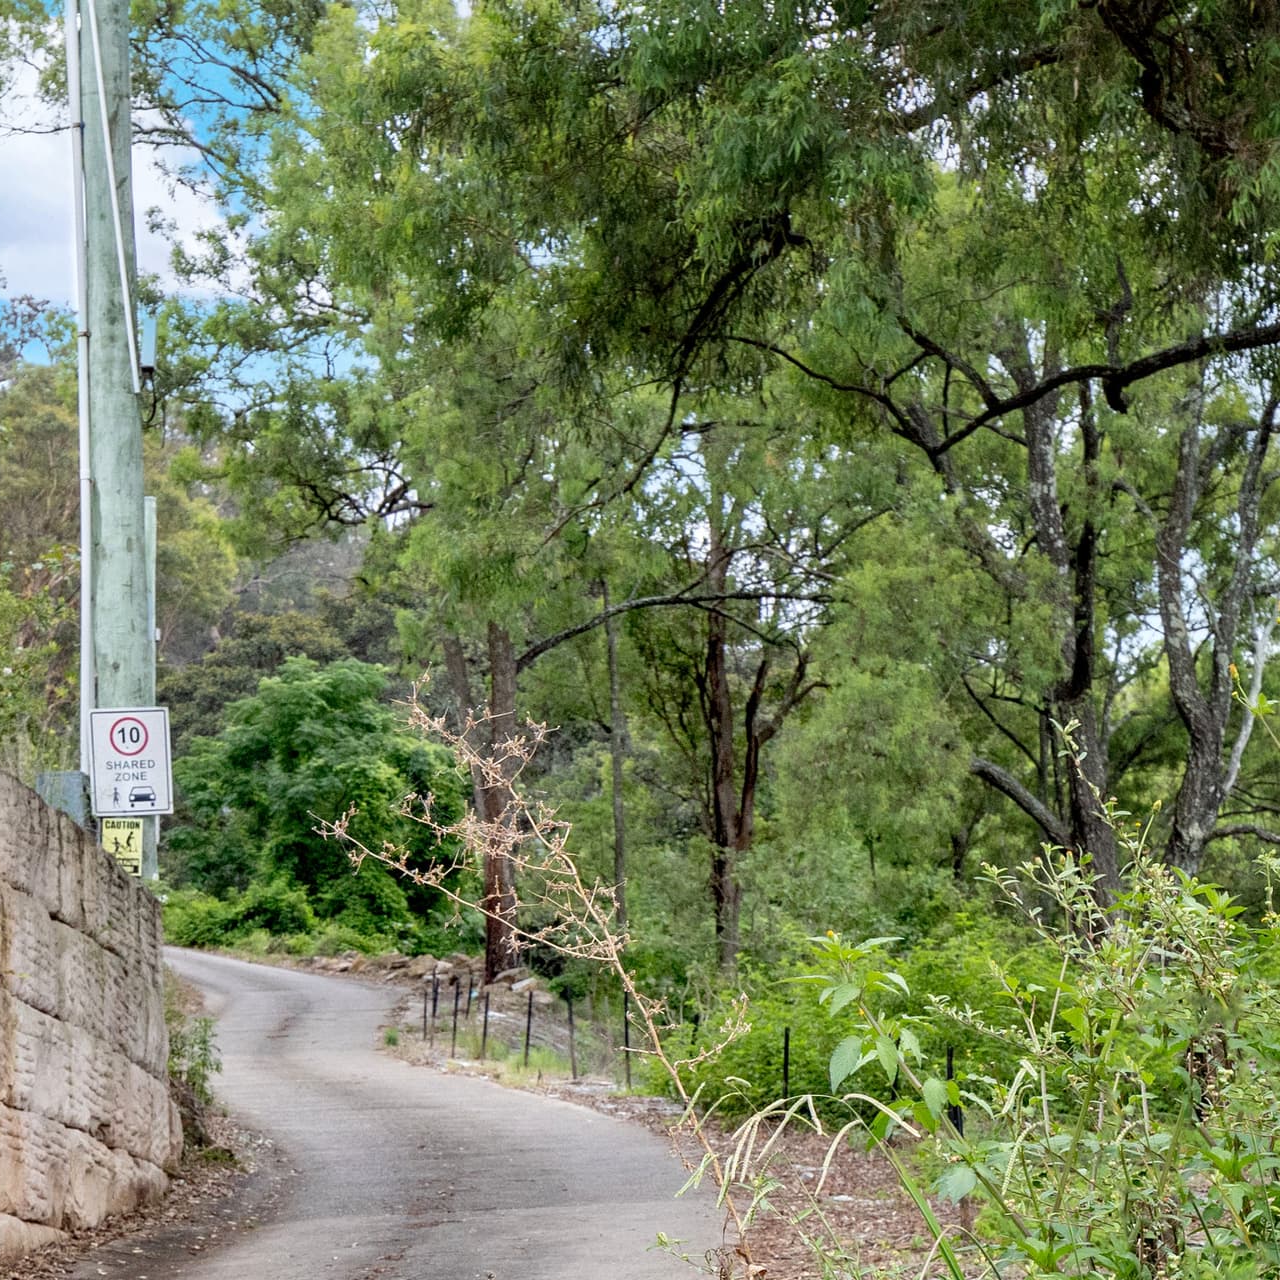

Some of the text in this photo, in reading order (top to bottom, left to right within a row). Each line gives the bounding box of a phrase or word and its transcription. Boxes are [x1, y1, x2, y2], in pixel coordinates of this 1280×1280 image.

[117, 727, 140, 744] 10
[105, 759, 156, 770] SHARED
[114, 771, 148, 782] ZONE
[105, 820, 141, 830] CAUTION
